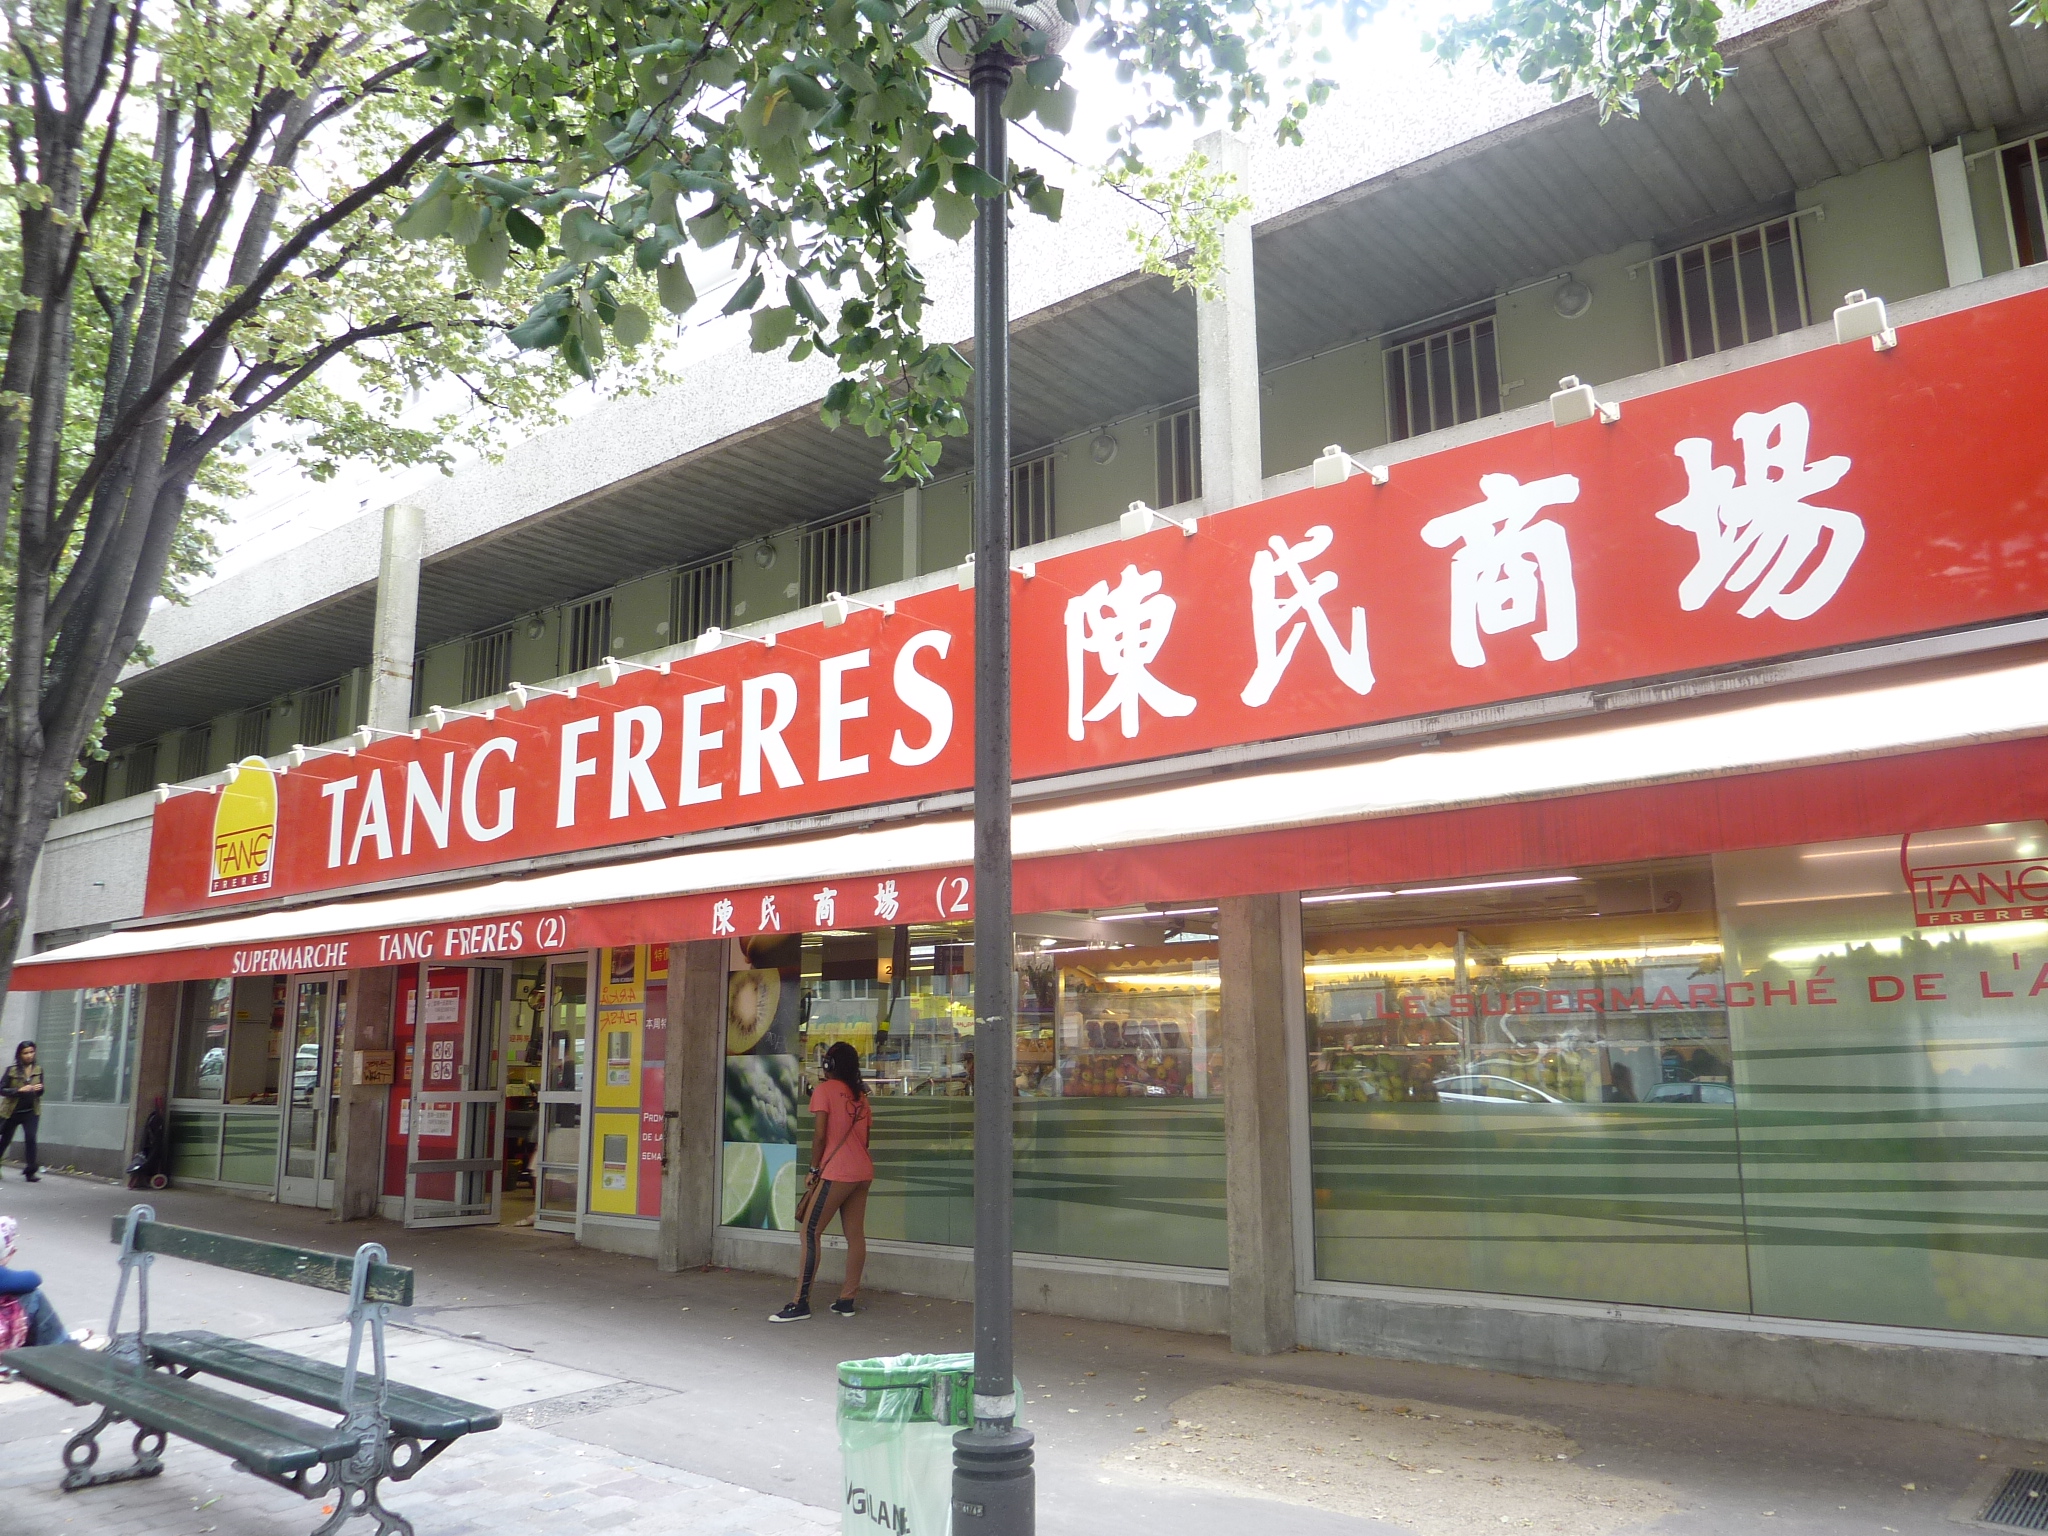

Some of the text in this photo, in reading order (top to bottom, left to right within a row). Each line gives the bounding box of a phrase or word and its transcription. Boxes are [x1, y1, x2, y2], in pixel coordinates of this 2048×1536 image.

[1063, 401, 1866, 742] 陳氏商場
[320, 629, 954, 869] TANG FRERES
[216, 832, 273, 874] TANG
[214, 873, 268, 890] FRERES
[711, 878, 901, 936] 陳氏商場
[231, 915, 567, 975] SUPERMARCHE TANG FRERES (2)
[1375, 992, 1428, 1019] LE
[1449, 966, 1838, 1017] SUPERMARCHÉ
[1868, 973, 1948, 1002] DE
[642, 1133, 653, 1141] DE
